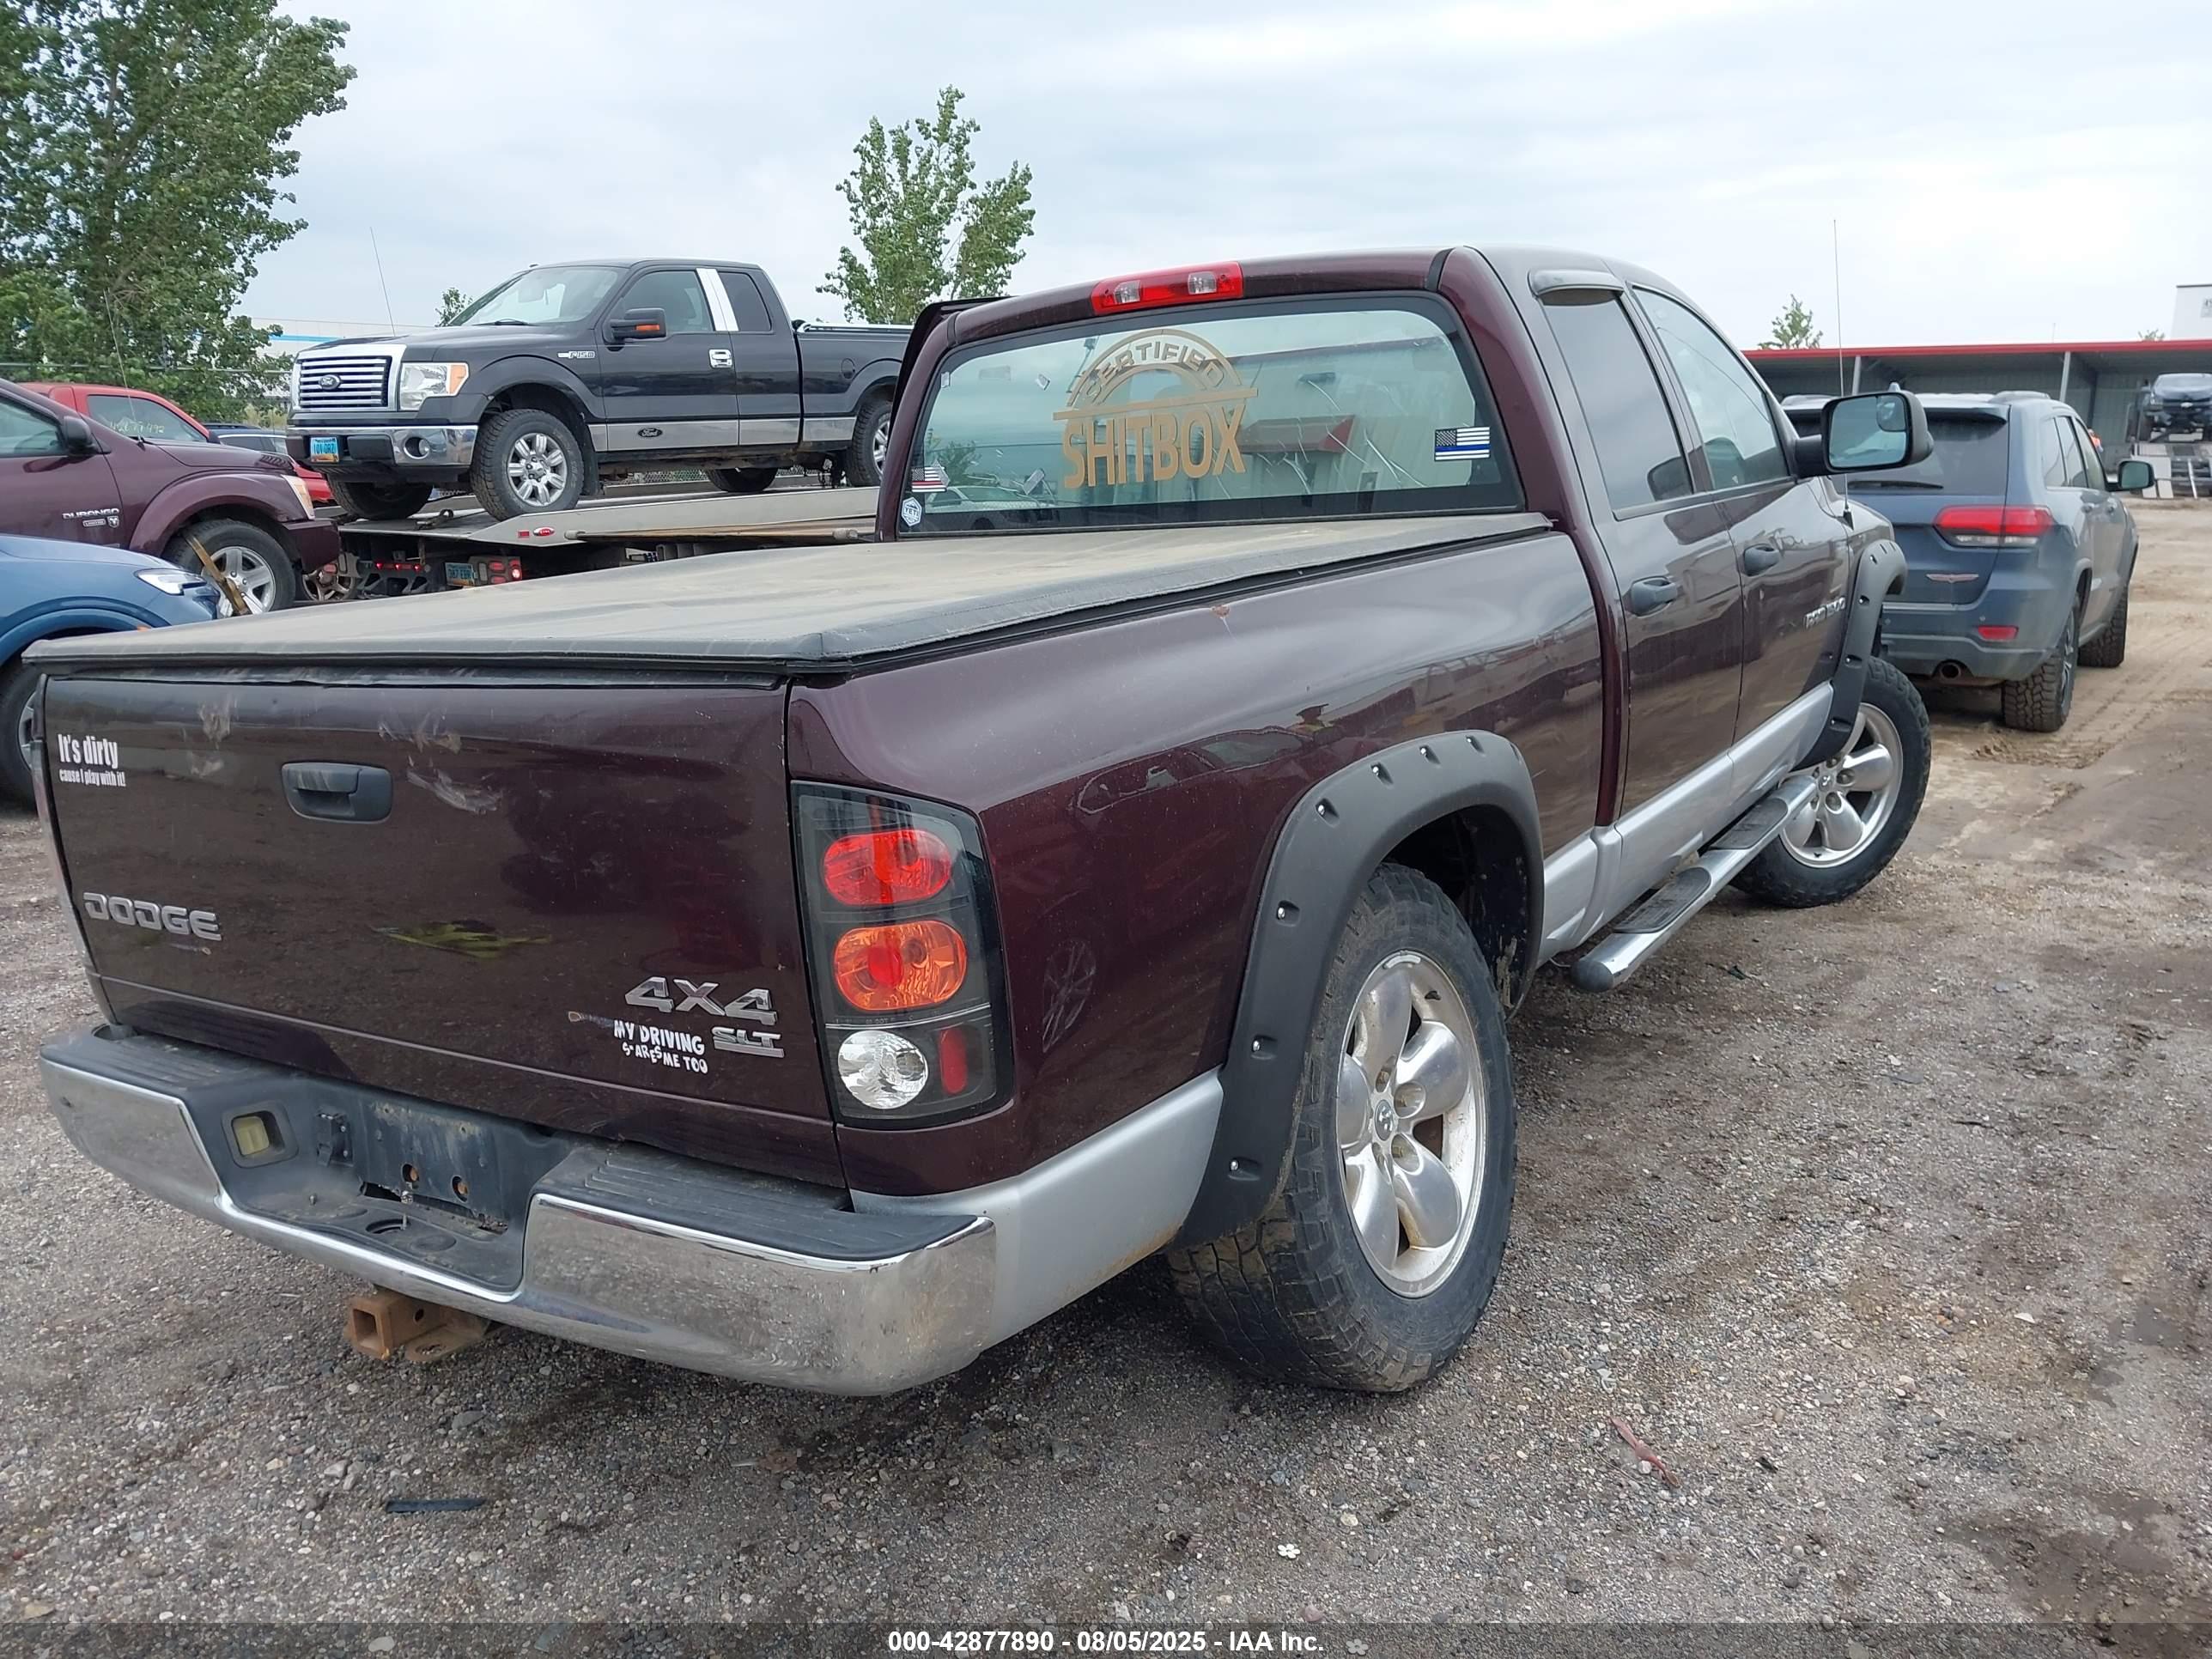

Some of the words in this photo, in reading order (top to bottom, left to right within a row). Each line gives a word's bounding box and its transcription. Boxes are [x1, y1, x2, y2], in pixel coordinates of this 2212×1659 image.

[1086, 342, 1224, 398] CERTIFIED
[1061, 404, 1246, 489] SHITBOX
[62, 507, 120, 520] DURANGO
[58, 733, 82, 764] It's
[82, 735, 118, 769] dirty
[59, 769, 81, 783] cause
[80, 769, 84, 784] I
[83, 769, 100, 787] play
[100, 770, 117, 787] with
[116, 771, 126, 787] it!
[83, 892, 222, 941] DODGE
[614, 1019, 635, 1041] MY
[639, 1024, 705, 1056] DRIVING
[712, 1026, 785, 1058] SLT
[663, 1052, 681, 1068] ME
[682, 1055, 708, 1074] TOO
